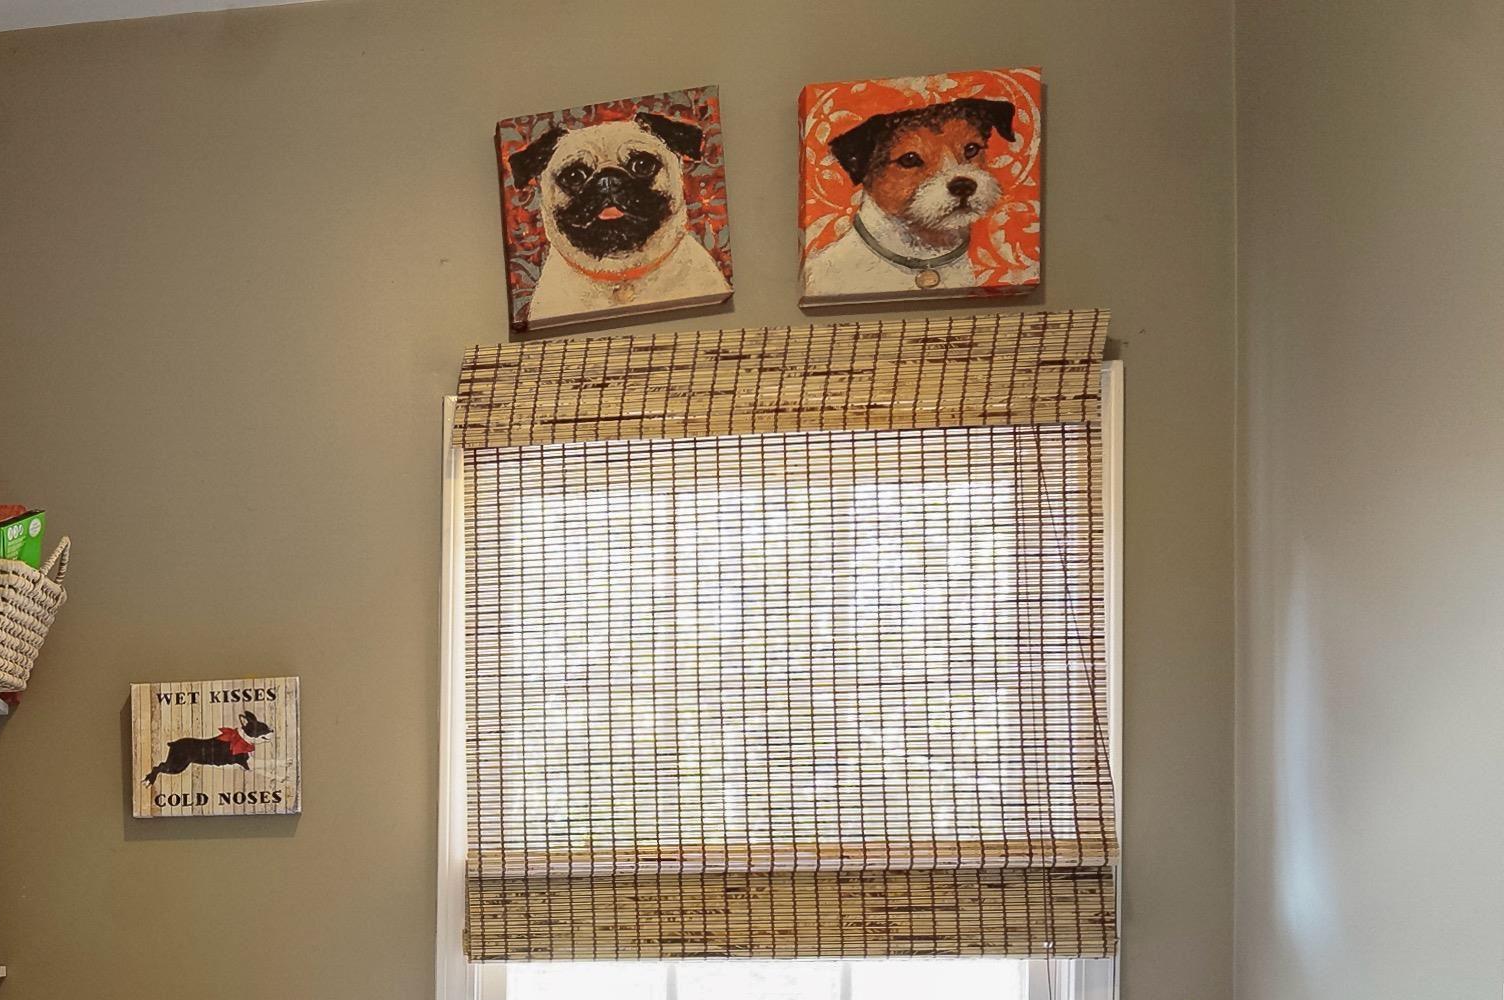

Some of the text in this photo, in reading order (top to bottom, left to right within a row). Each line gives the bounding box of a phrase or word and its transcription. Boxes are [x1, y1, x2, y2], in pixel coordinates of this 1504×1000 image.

[156, 687, 277, 706] WET KISSES
[154, 790, 282, 807] COLD NOSES
